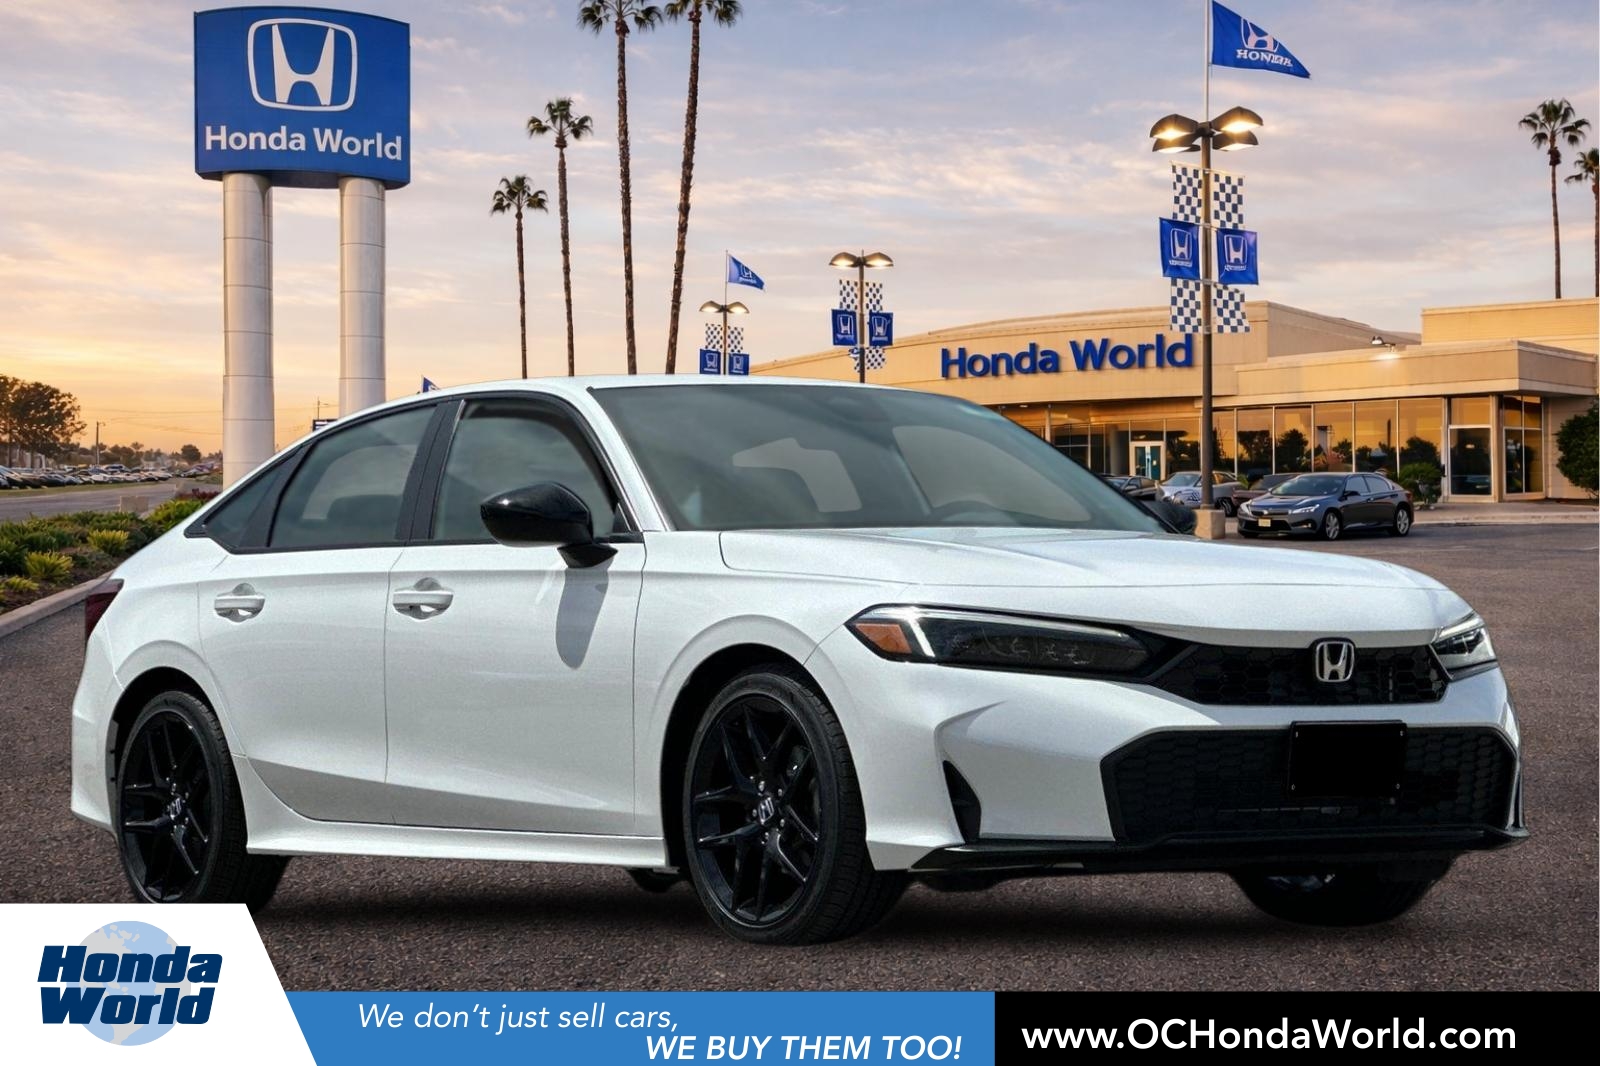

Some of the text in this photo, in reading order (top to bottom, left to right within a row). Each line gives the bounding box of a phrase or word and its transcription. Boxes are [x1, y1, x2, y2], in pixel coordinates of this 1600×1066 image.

[205, 125, 402, 161] Honda World
[941, 333, 1194, 378] Honda World
